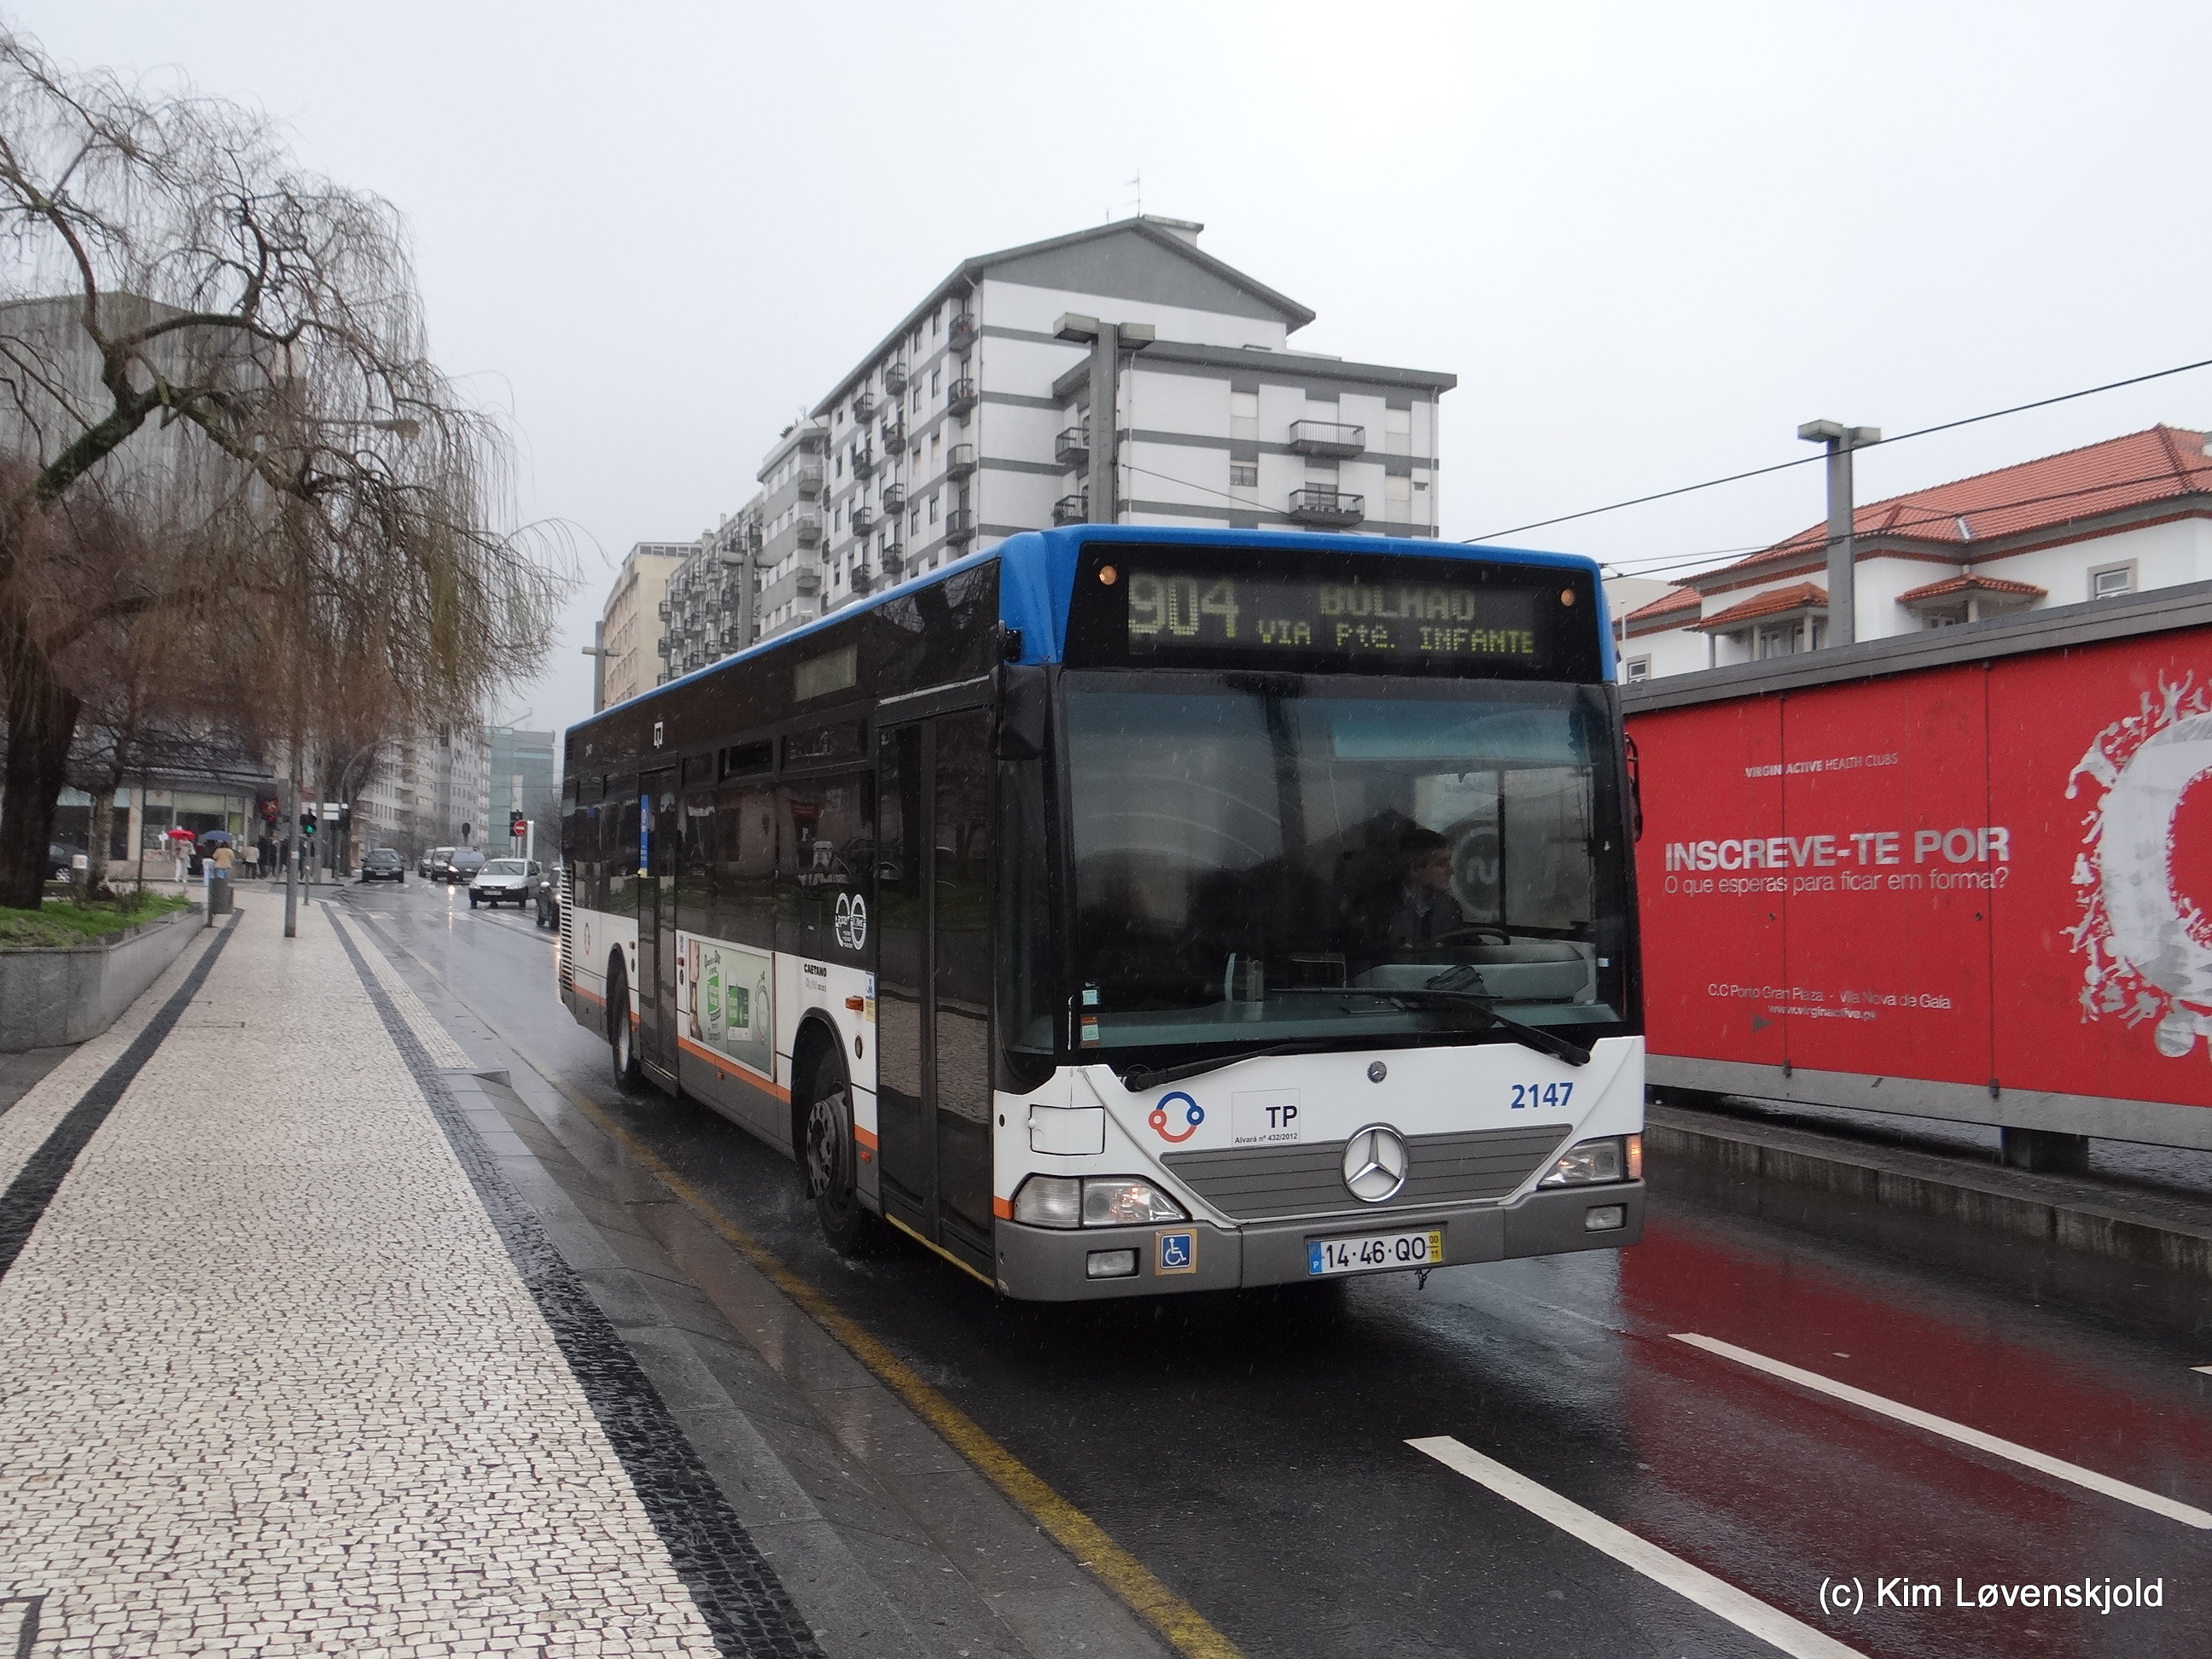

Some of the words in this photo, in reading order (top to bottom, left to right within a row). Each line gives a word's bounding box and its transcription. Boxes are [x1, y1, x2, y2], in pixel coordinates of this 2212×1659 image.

[1128, 573, 1238, 637] 904
[1258, 619, 1311, 644] VIA
[1420, 626, 1534, 654] INFANTE
[1745, 764, 1783, 777] VIRGIN
[1785, 760, 1823, 775] ACTIVE
[1825, 756, 1862, 771] HEALTH
[1865, 753, 1898, 767] CLUBS
[1665, 832, 1901, 871] INSCREVE-TE
[1914, 827, 2010, 864] POR
[1665, 876, 1679, 894] O
[1683, 878, 1713, 897] que
[1719, 876, 1787, 897] esperas
[1793, 876, 1835, 896] para
[1840, 870, 1883, 890] ficar
[1888, 872, 1923, 889] em
[1929, 866, 2010, 889] forma?
[804, 963, 827, 977] CAETANO
[1730, 985, 1761, 998] Porto
[1762, 986, 1790, 999] Gran
[1792, 987, 1824, 1002] Plaza
[1899, 993, 1918, 1007] de
[1919, 993, 1952, 1009] Gaia
[1511, 1082, 1574, 1109] 2147
[1266, 1105, 1297, 1128] TP
[1235, 1135, 1257, 1144] Alvará
[1267, 1132, 1298, 1141] 432/2012
